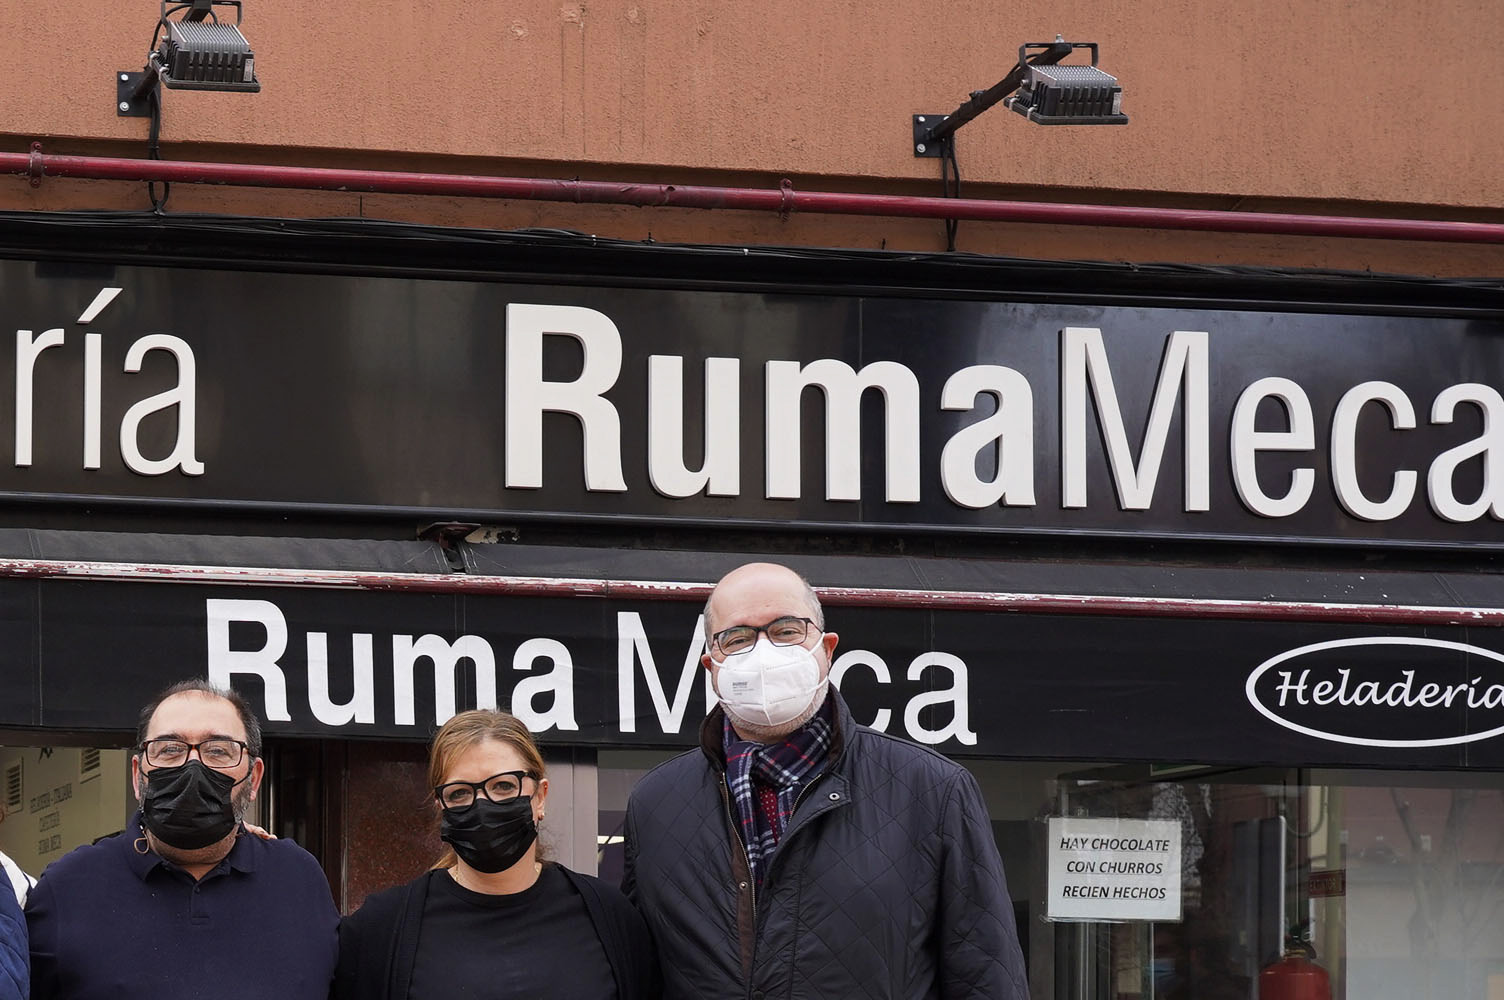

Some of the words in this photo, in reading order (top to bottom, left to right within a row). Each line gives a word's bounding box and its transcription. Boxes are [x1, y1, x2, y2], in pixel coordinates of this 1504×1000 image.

[206, 598, 579, 731] Ruma
[617, 612, 978, 746] Mca
[1060, 838, 1089, 850] HAY
[1091, 838, 1170, 852] CHOCOLATE
[1066, 861, 1096, 873] CON
[1099, 862, 1163, 874] CHURROS
[1062, 886, 1110, 898] RECIEN
[1113, 887, 1167, 900] HECHOS
